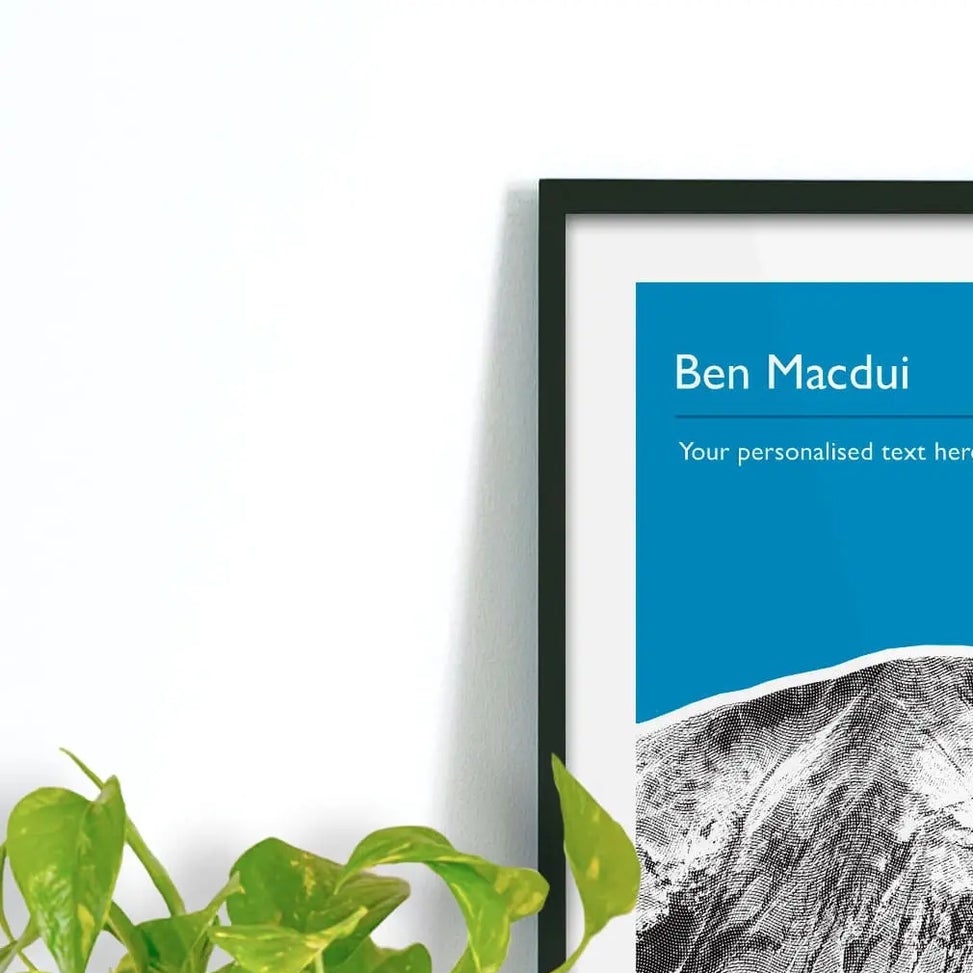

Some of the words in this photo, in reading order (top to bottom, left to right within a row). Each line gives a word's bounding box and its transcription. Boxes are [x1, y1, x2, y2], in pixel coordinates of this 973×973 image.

[676, 353, 749, 390] Ben
[768, 353, 909, 390] Macdui
[678, 441, 730, 461] Your
[738, 441, 873, 467] personalised
[881, 446, 927, 461] text
